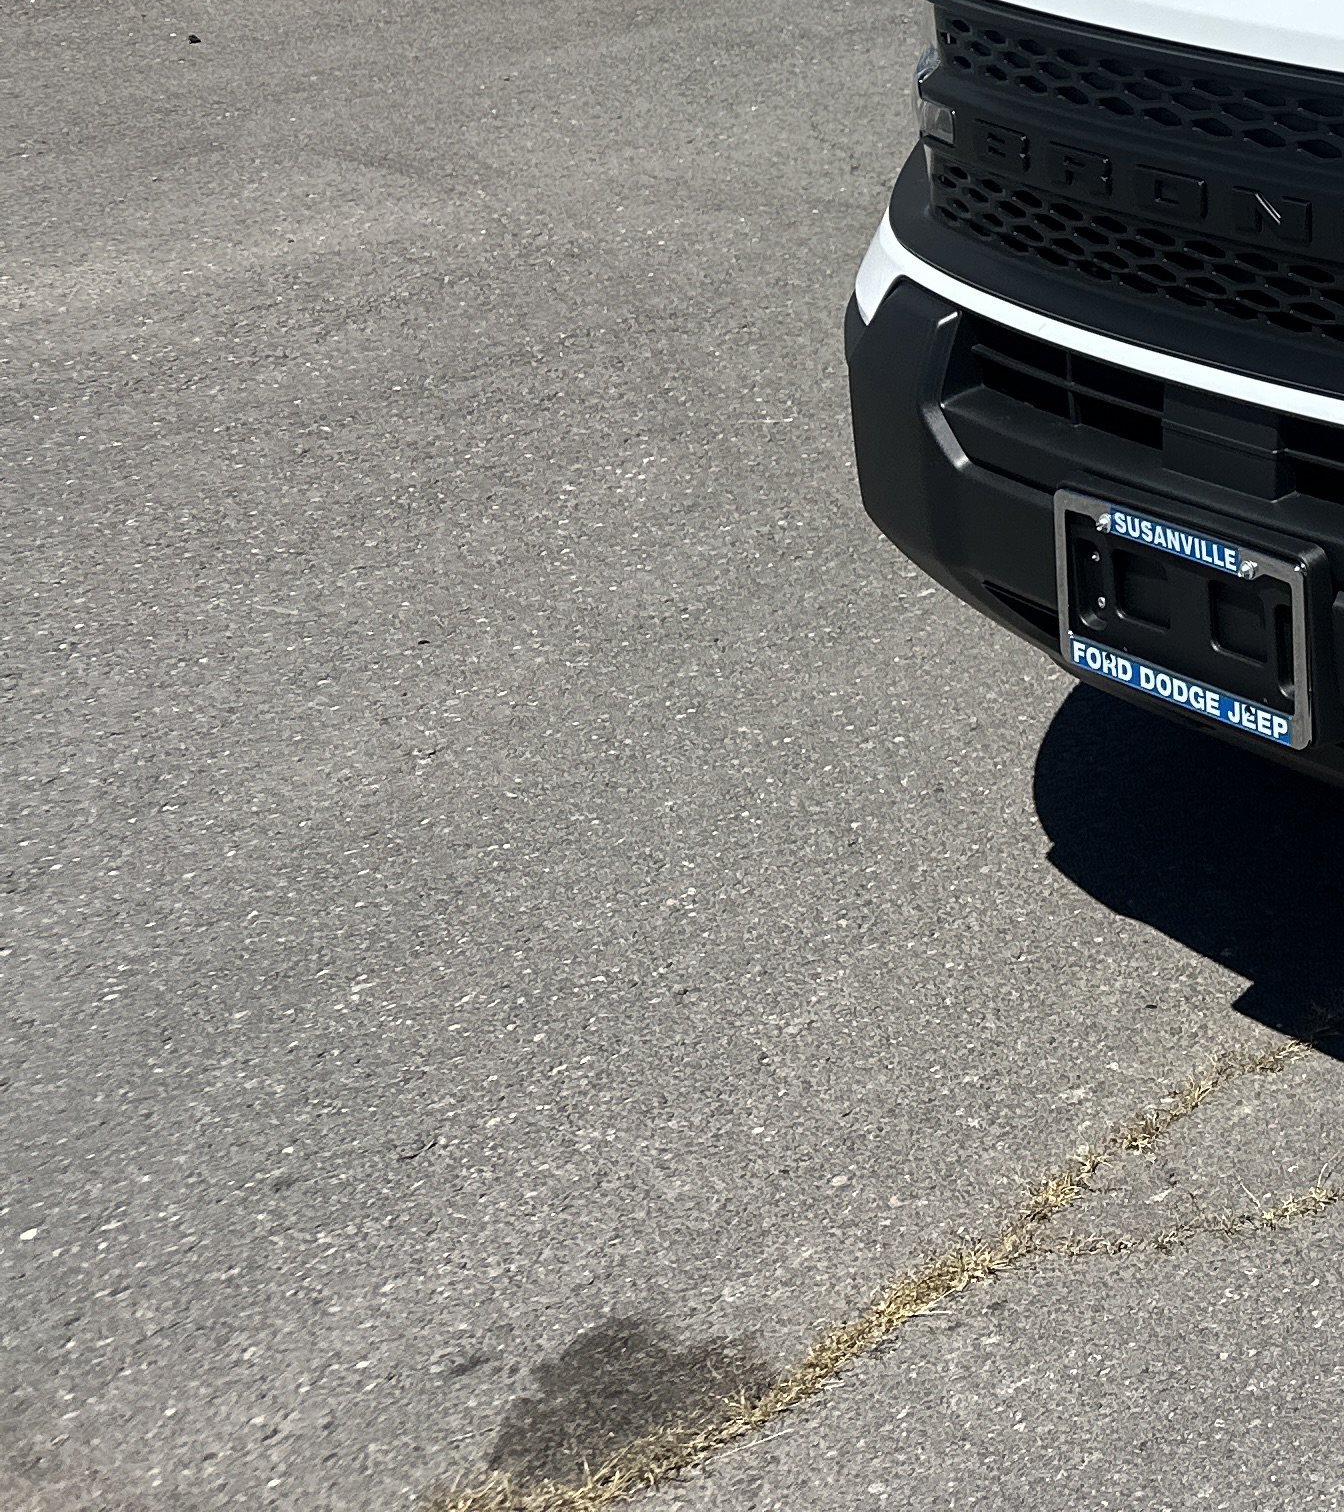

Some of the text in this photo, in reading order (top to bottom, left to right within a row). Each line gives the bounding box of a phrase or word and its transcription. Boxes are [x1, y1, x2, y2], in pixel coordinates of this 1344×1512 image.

[1114, 512, 1237, 571] SUSANVILLE
[1073, 641, 1289, 739] FORD DODGE JEEP
